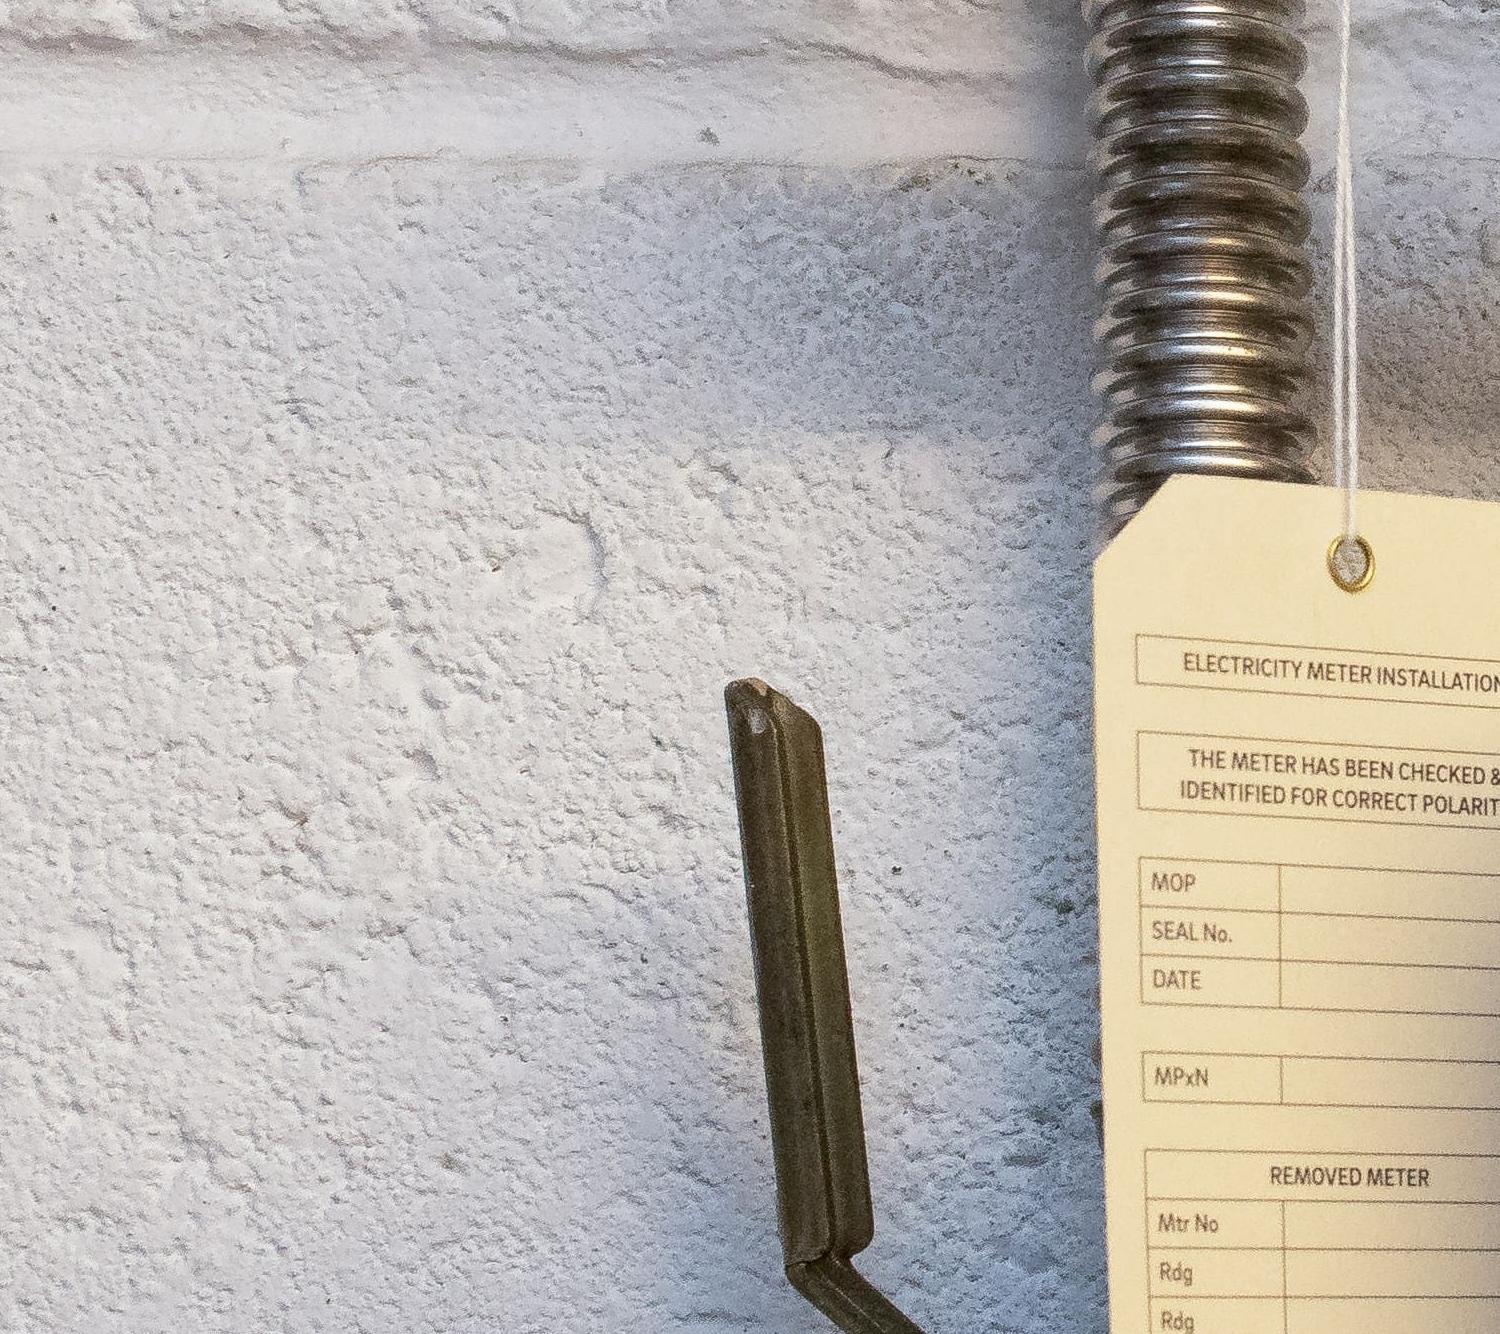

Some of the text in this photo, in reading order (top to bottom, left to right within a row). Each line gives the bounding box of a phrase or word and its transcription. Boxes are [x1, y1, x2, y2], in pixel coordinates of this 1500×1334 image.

[1183, 651, 1302, 680] ELECTRICITY
[1307, 662, 1373, 685] METER
[1189, 748, 1227, 770] THE
[1231, 750, 1297, 774] METER
[1301, 755, 1340, 777] HAS
[1345, 757, 1394, 780] BEEN
[1398, 760, 1486, 786] CHECKED
[1180, 779, 1287, 806] IDENTIFIED
[1291, 786, 1328, 808] FOR
[1332, 788, 1419, 812] CORRECT
[1151, 872, 1196, 893] MOP
[1152, 920, 1233, 944] SEAL No.
[1152, 970, 1202, 991] DATE
[1154, 1067, 1209, 1088] MPxN
[1270, 1166, 1430, 1188] REMOVED METER
[1158, 1214, 1219, 1234] Mtr No
[1160, 1262, 1193, 1286] Rdg
[1161, 1311, 1195, 1334] Rdg
